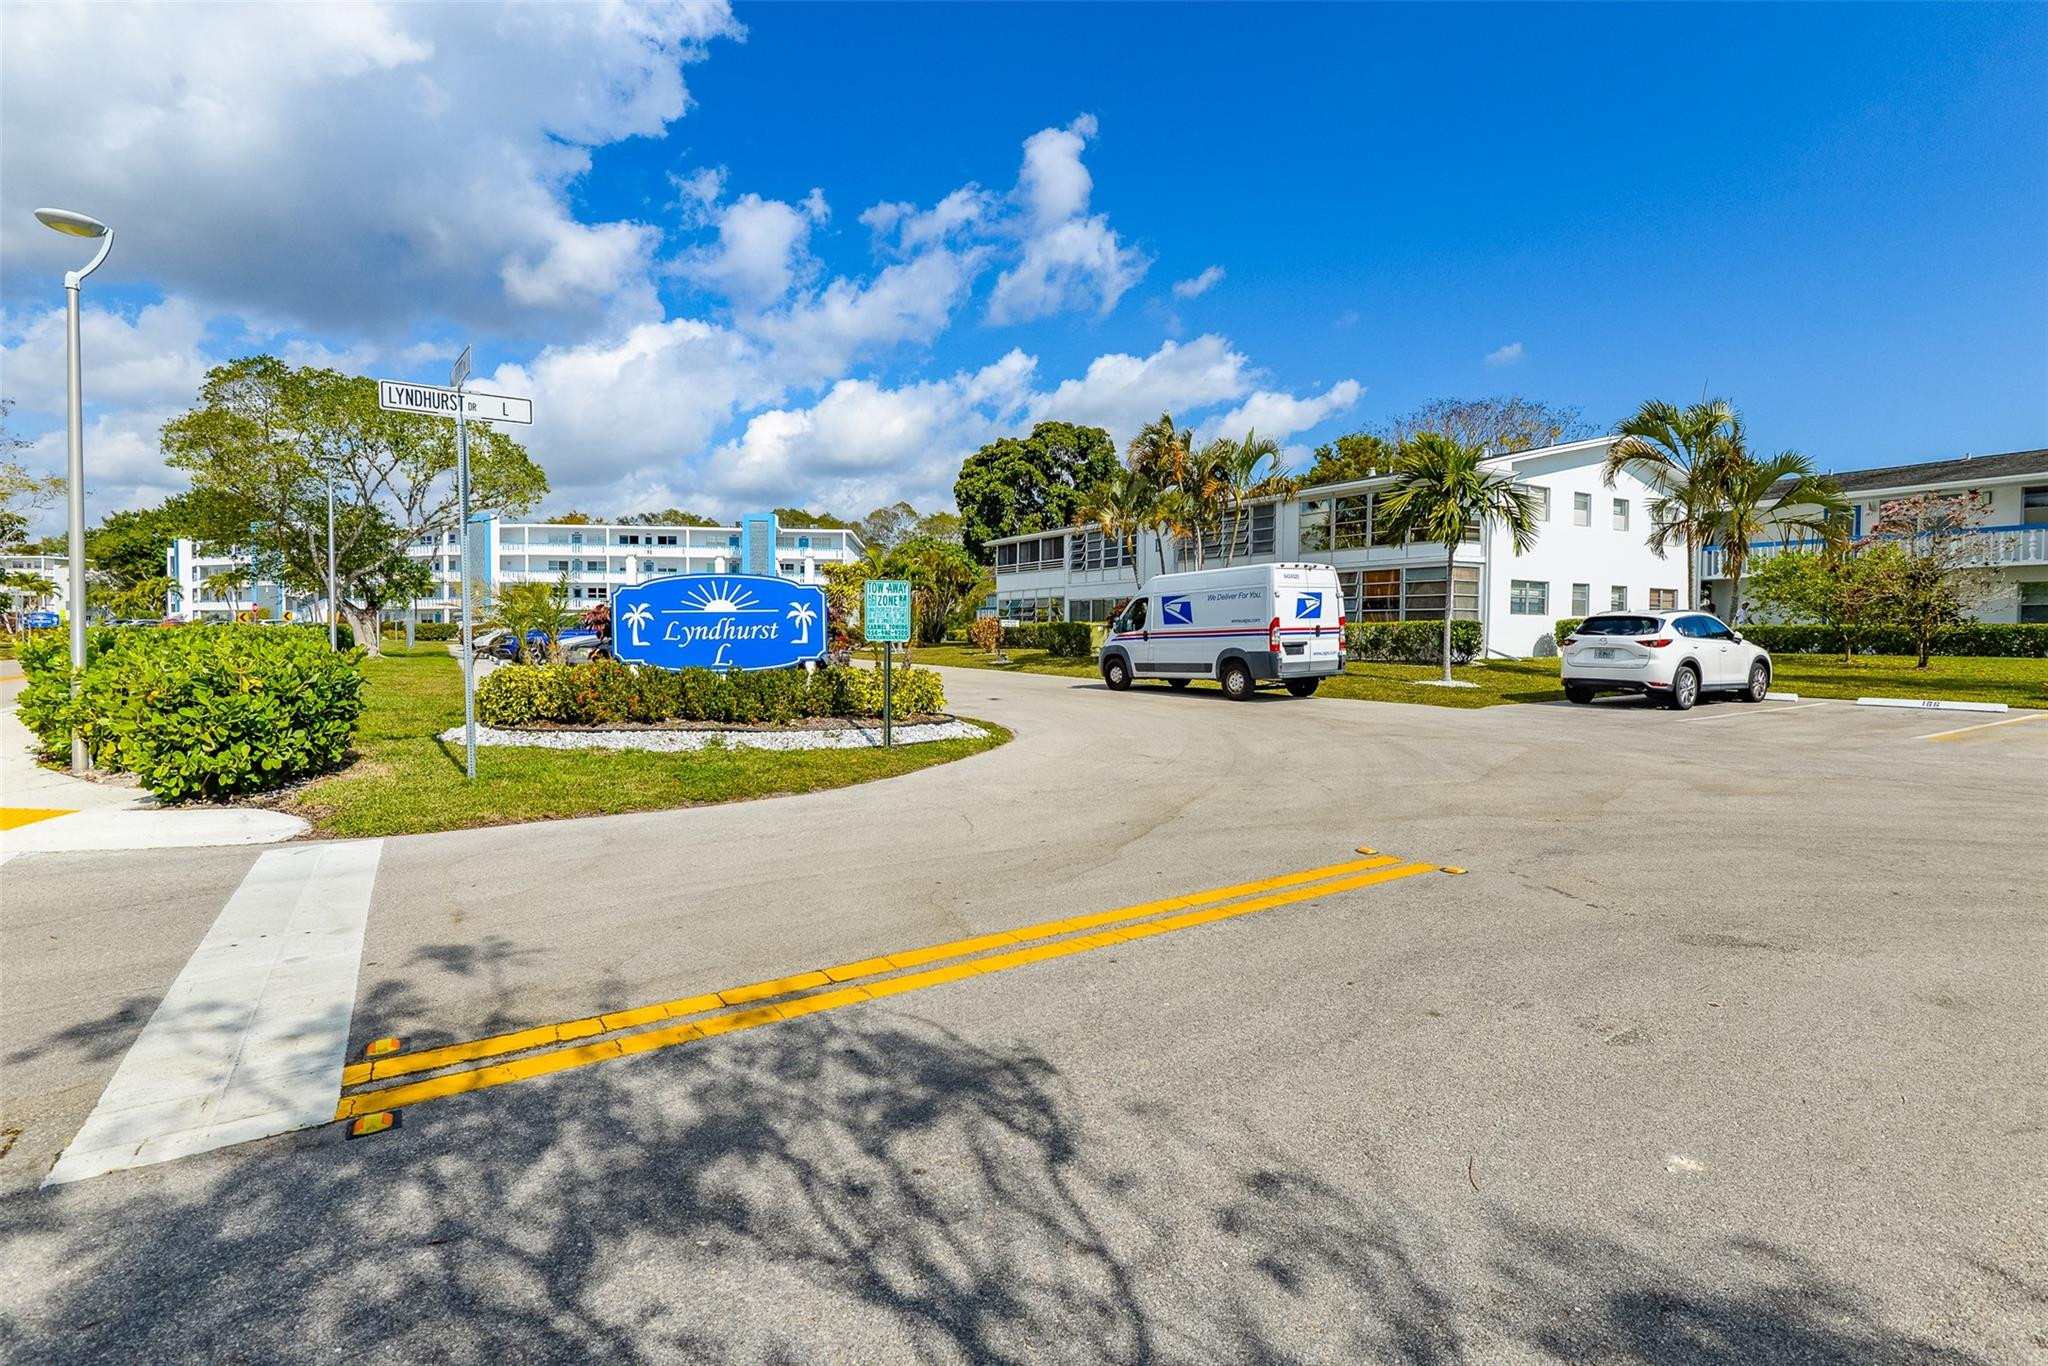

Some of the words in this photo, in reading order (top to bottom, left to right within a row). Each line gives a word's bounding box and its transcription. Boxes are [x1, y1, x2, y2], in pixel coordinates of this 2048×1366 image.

[389, 386, 465, 412] LYNDHURST
[468, 402, 477, 412] DR
[503, 402, 509, 417] L
[877, 594, 898, 607] ZONE
[1207, 593, 1216, 601] We
[1217, 593, 1237, 601] Deliver
[1238, 591, 1249, 599] For
[663, 618, 779, 648] Lyndhurst
[712, 643, 733, 666] L
